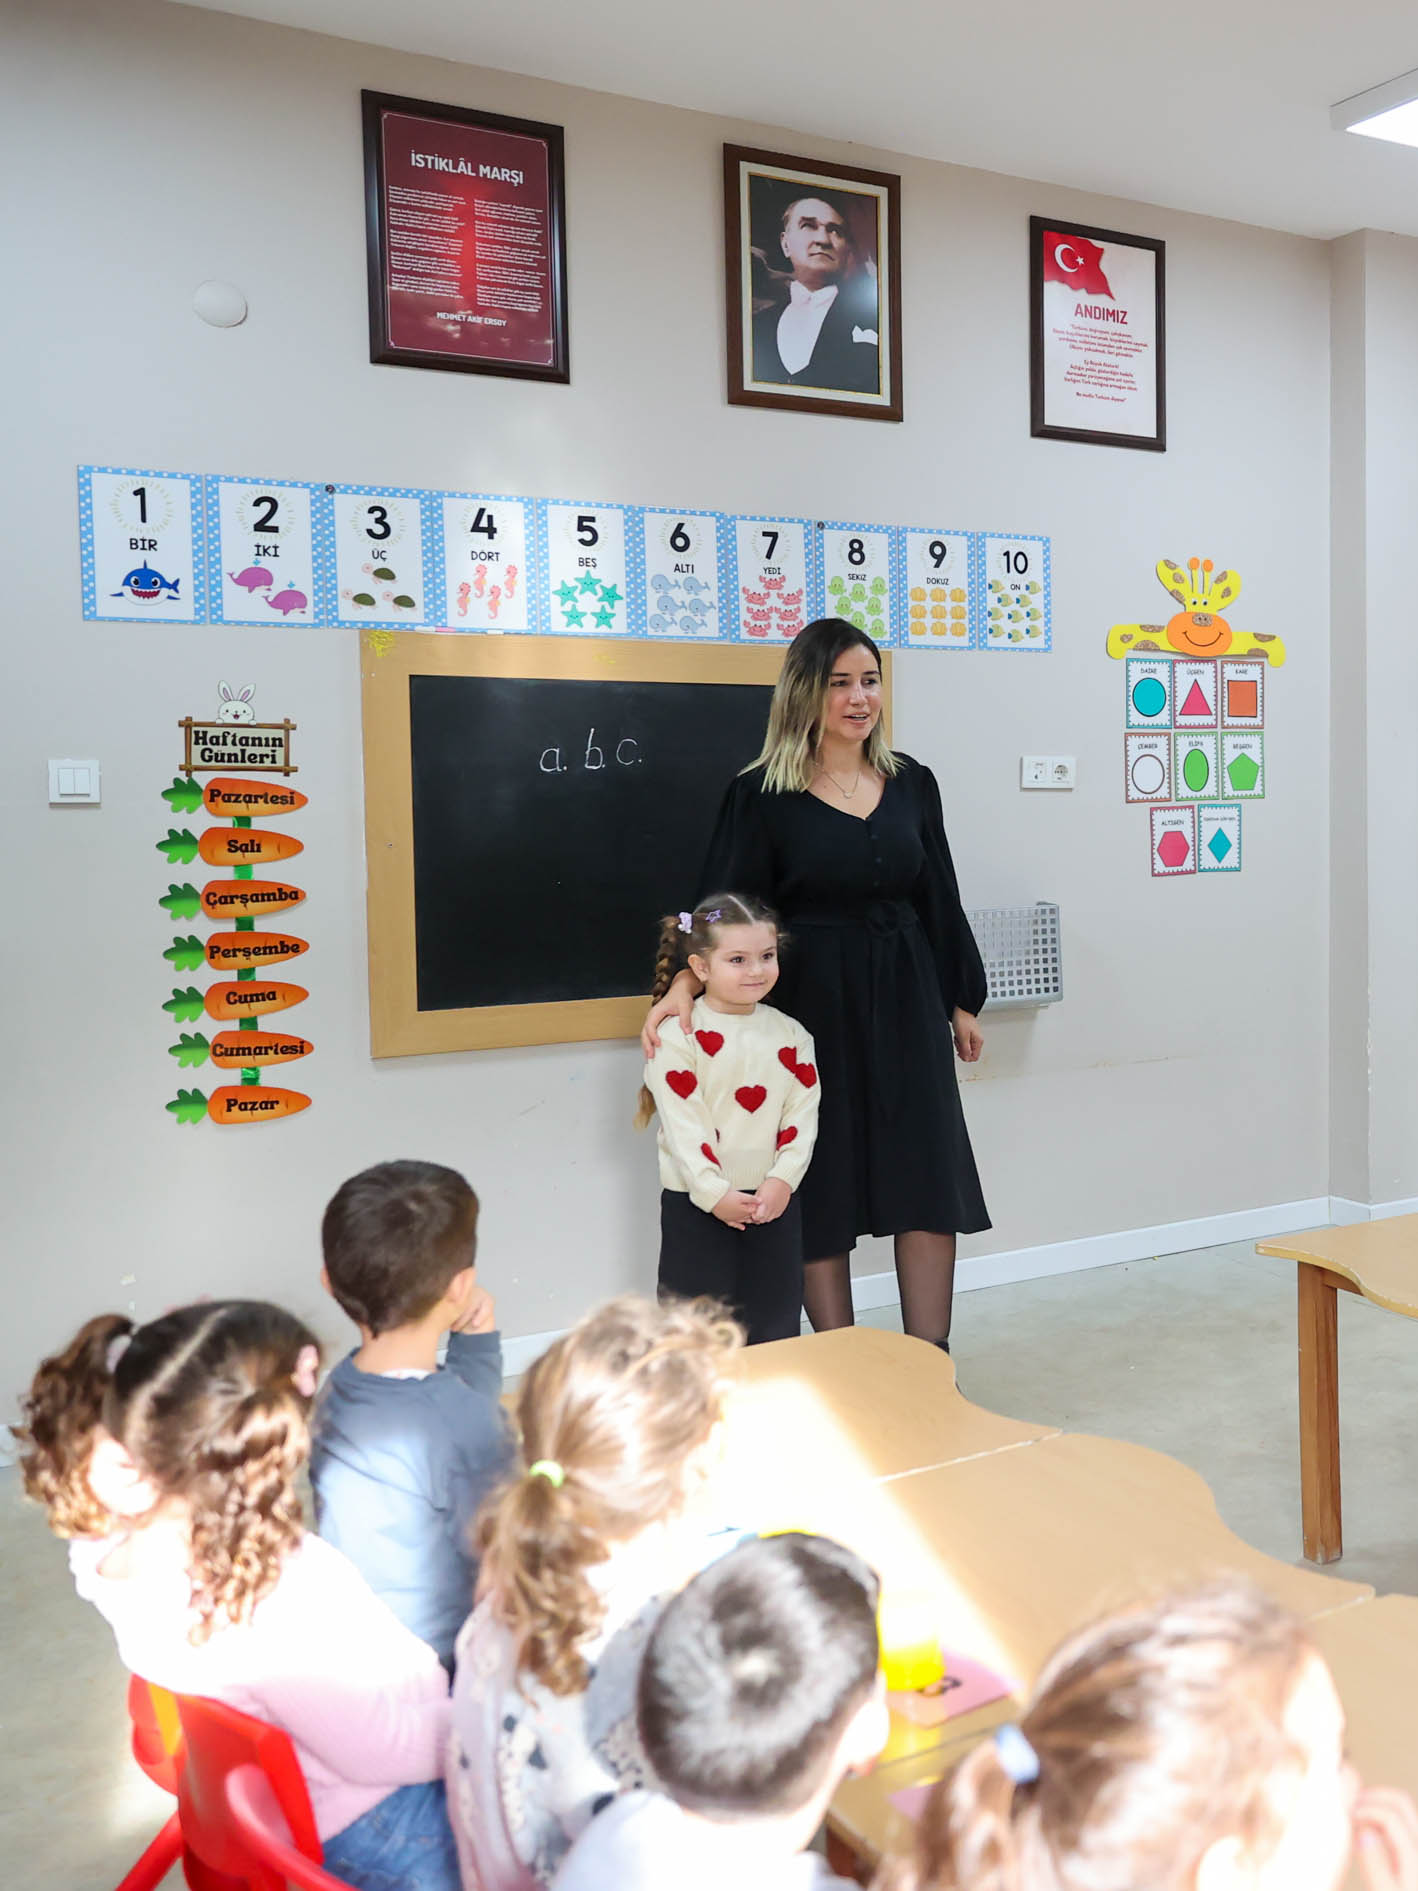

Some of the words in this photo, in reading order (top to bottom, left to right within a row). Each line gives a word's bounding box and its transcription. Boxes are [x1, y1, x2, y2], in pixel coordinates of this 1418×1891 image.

[411, 149, 476, 177] İSTİKLÂL
[479, 165, 524, 187] MARŞI
[1074, 303, 1129, 325] ANDIMIZ
[132, 486, 148, 524] 1
[251, 495, 280, 534] 2
[365, 505, 392, 540] 3
[470, 507, 498, 540] 4
[576, 515, 599, 547] 5
[129, 538, 158, 552] BİR
[669, 522, 691, 553] 6
[761, 531, 780, 560] 7
[254, 544, 280, 558] İKİ
[371, 548, 388, 562] ÜÇ
[470, 549, 501, 563] DÖRT
[847, 538, 866, 566] 8
[928, 540, 948, 569] 9
[578, 557, 598, 570] BEŞ
[673, 563, 695, 575] ALTI
[1002, 550, 1029, 575] 10
[926, 576, 949, 586] DOKUZ
[1010, 583, 1021, 591] ON
[193, 729, 285, 749] Haftanın
[200, 747, 278, 765] Günleri
[209, 788, 295, 806] Pazartesi
[227, 839, 263, 854] Salı
[205, 887, 299, 910] Çarşamba
[208, 940, 301, 960] Perşembe
[225, 991, 277, 1006] Cuma
[211, 1041, 305, 1057] Cumartesi
[225, 1098, 280, 1113] Pazar
